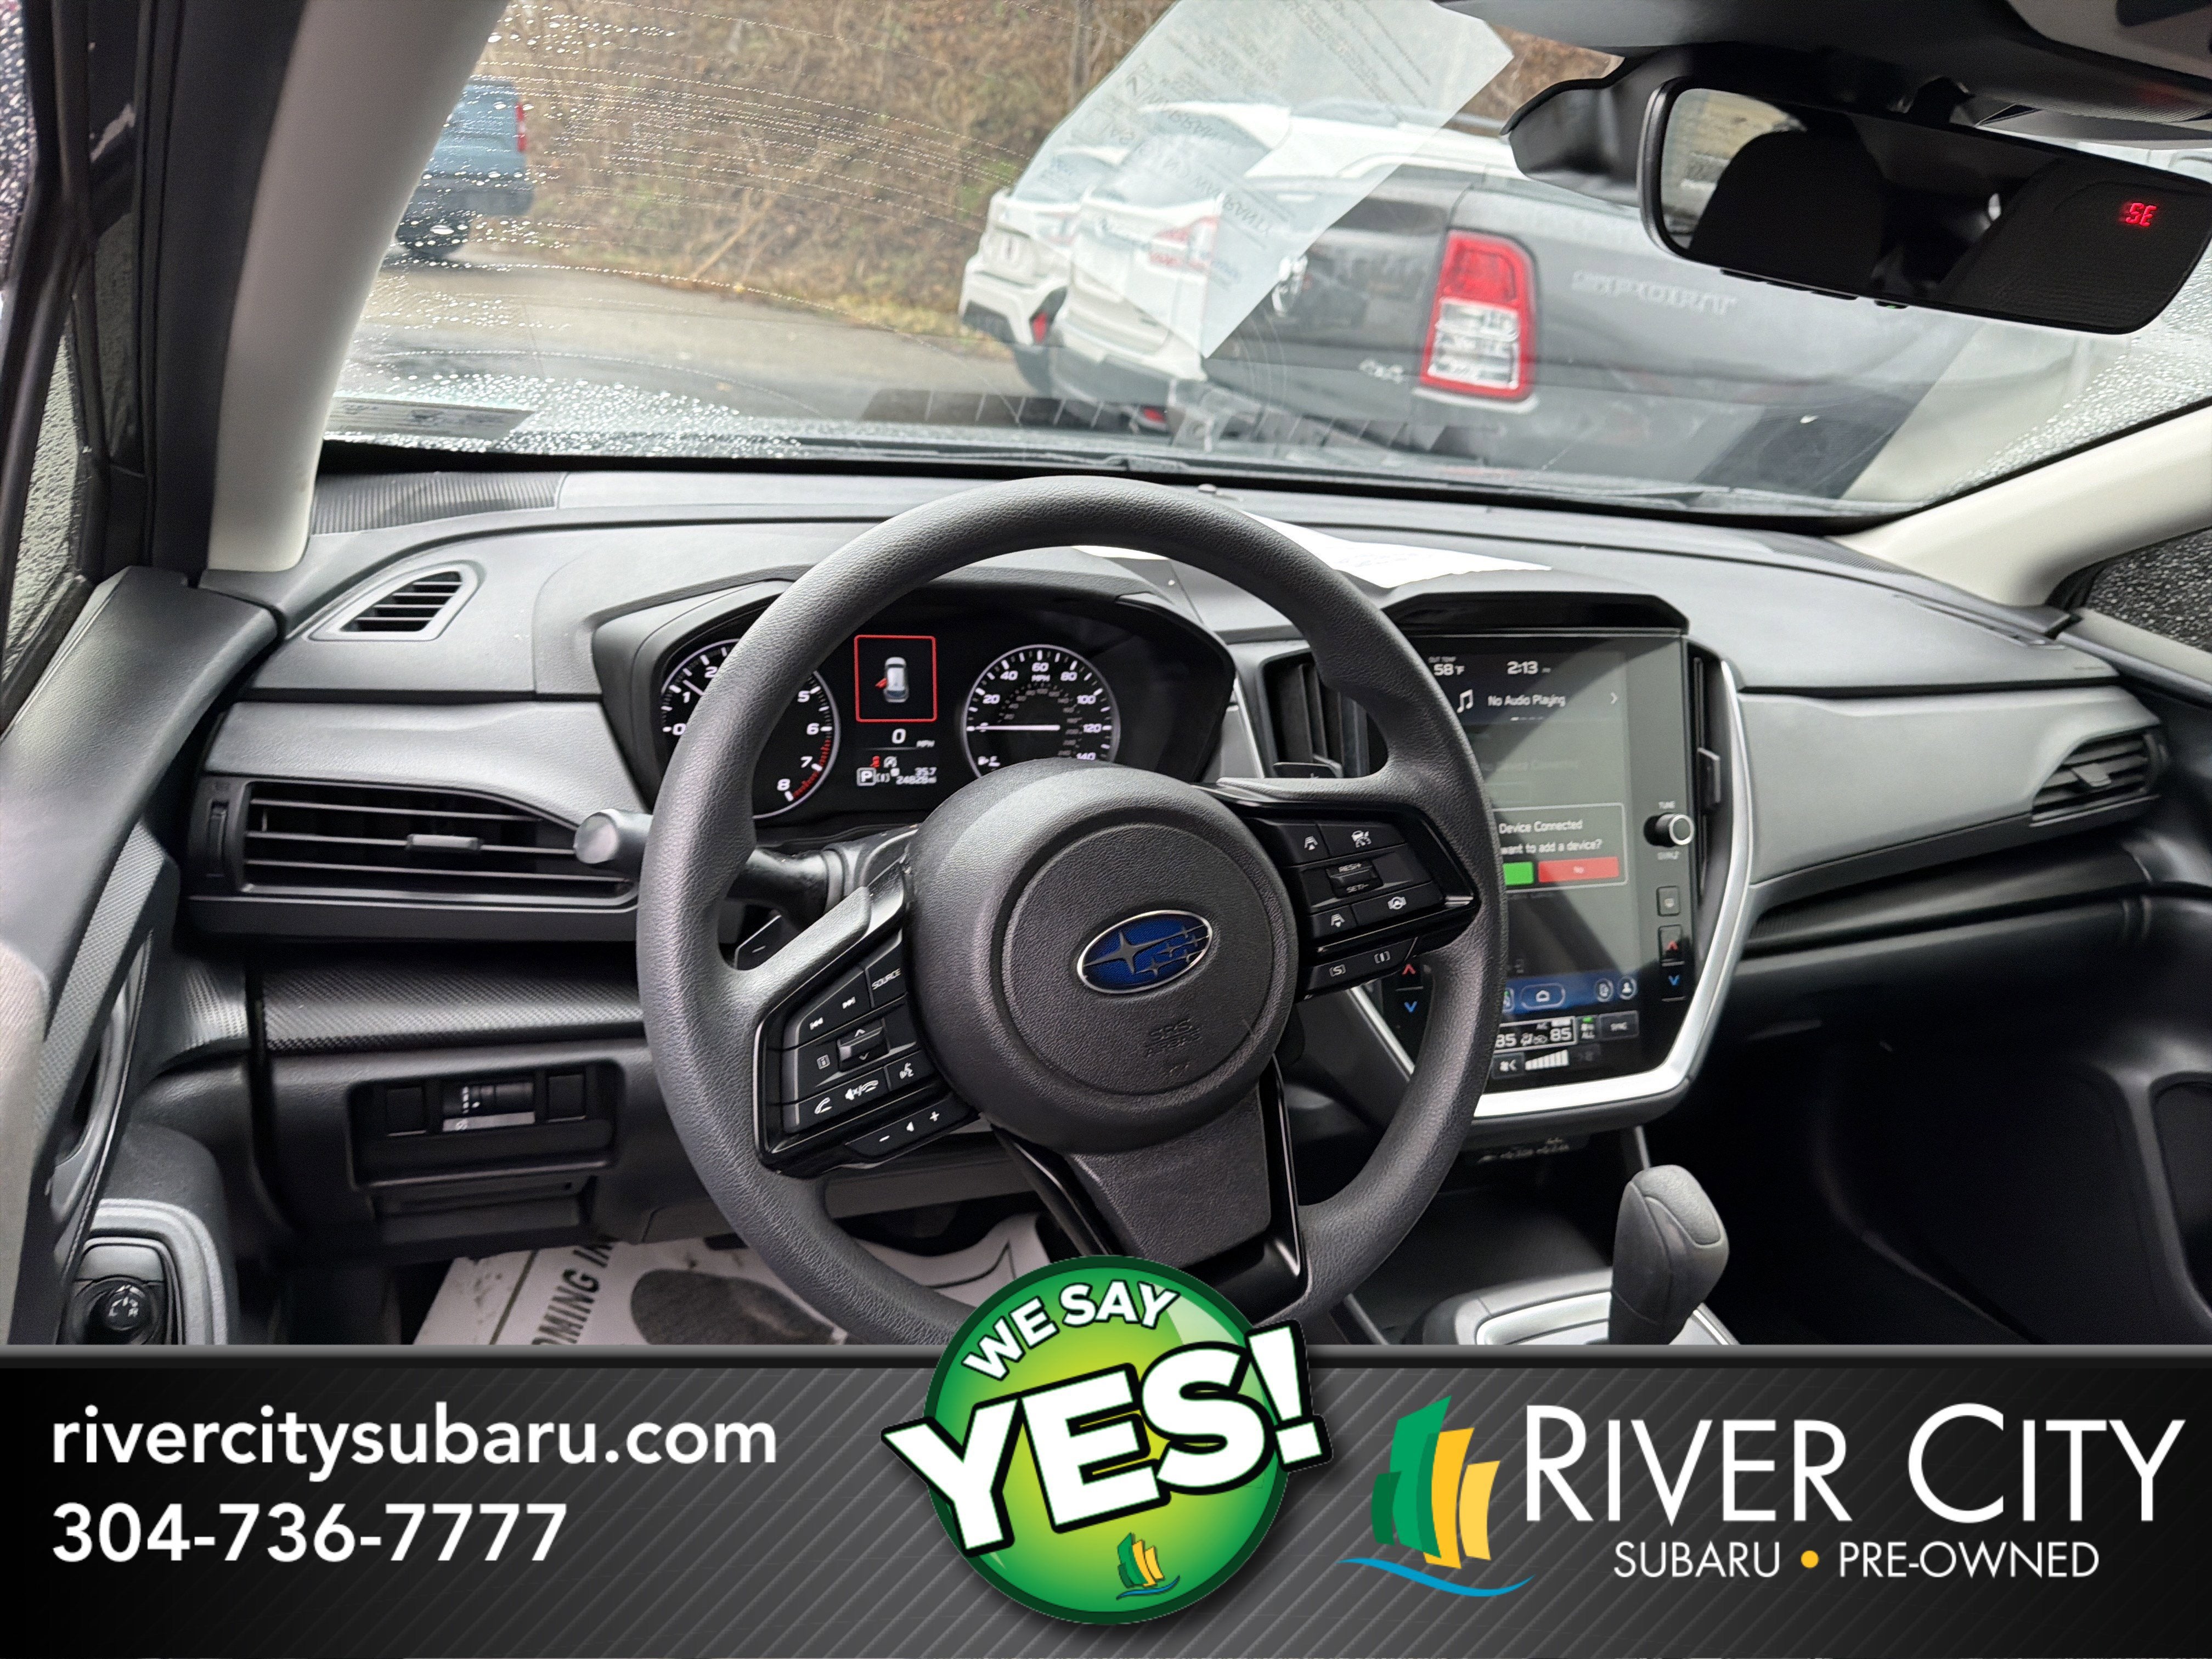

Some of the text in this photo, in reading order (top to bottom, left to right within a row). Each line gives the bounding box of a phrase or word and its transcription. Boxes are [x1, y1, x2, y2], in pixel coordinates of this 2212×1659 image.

[2125, 202, 2157, 227] SE
[704, 666, 717, 678] 2
[1031, 662, 1049, 672] 60
[1507, 661, 1538, 674] 2:13
[1000, 670, 1018, 681] 40
[683, 691, 691, 703] 1
[797, 690, 810, 703] 5
[983, 694, 1000, 704] 20
[1077, 695, 1097, 704] 100
[1487, 693, 1566, 708] No Audio Playing
[672, 723, 686, 736] 0
[806, 723, 820, 735] 6
[1083, 723, 1102, 733] 120
[891, 728, 906, 744] 0
[800, 755, 813, 768] 7
[861, 770, 873, 782] P
[777, 778, 791, 791] 8
[1498, 819, 1584, 834] Device Connected
[1525, 842, 1537, 854] to
[1538, 841, 1556, 853] add
[1558, 843, 1565, 852] a
[1566, 838, 1604, 851] device?
[871, 967, 902, 990] SOURCE
[1549, 1027, 1572, 1042] 85
